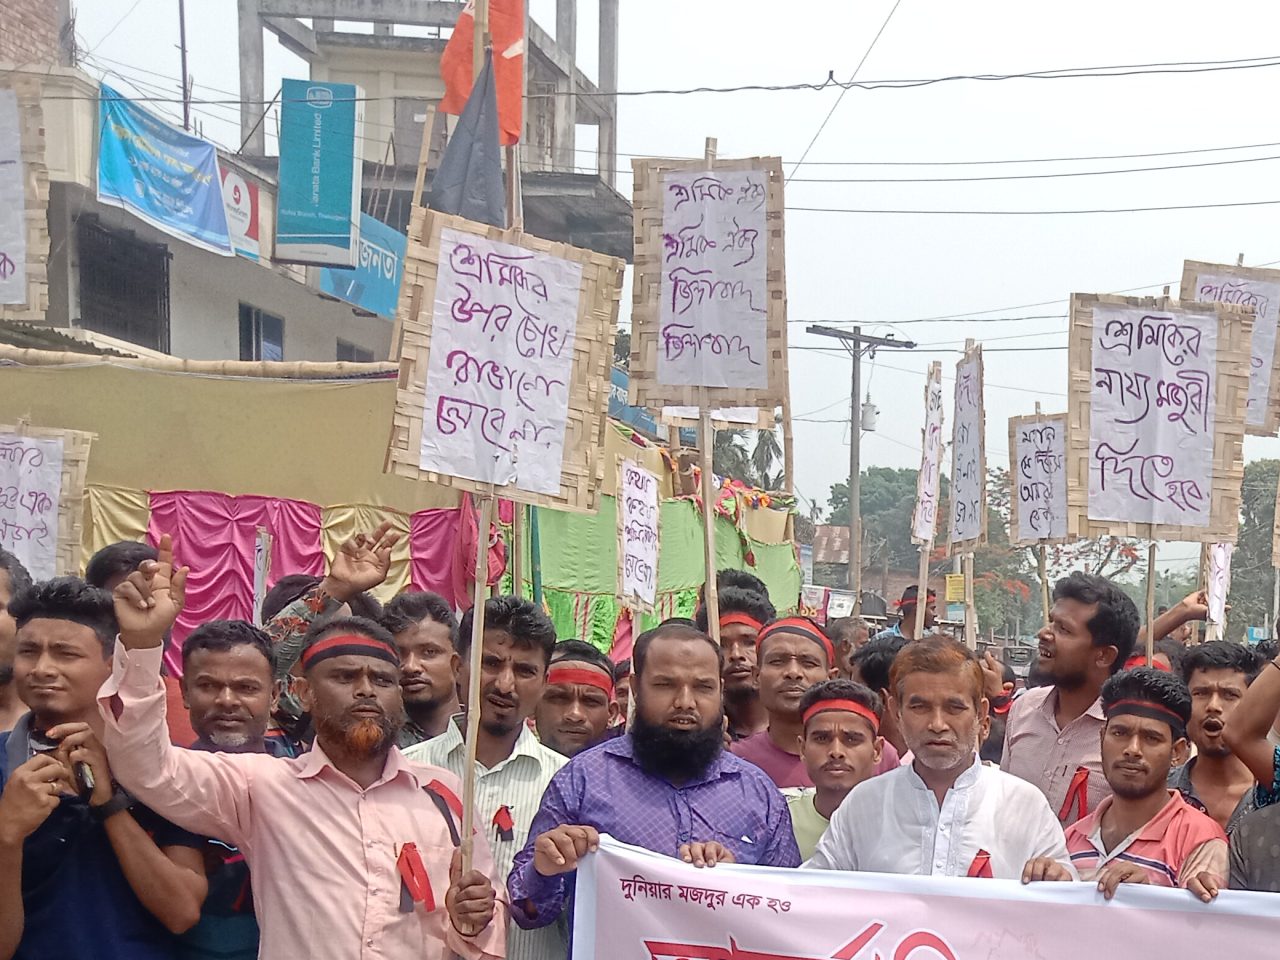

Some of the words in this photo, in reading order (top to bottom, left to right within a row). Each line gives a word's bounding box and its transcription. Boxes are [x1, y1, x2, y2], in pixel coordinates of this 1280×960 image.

[312, 112, 322, 148] Limited
[311, 149, 321, 174] Bank
[359, 239, 398, 286] জনতা
[1100, 316, 1201, 366] শ্রমিকের
[1096, 439, 1174, 502] দিতে
[620, 876, 673, 900] দুনিয়ার
[678, 885, 728, 909] মজদুর
[732, 892, 760, 910] এক
[767, 897, 791, 914] হও
